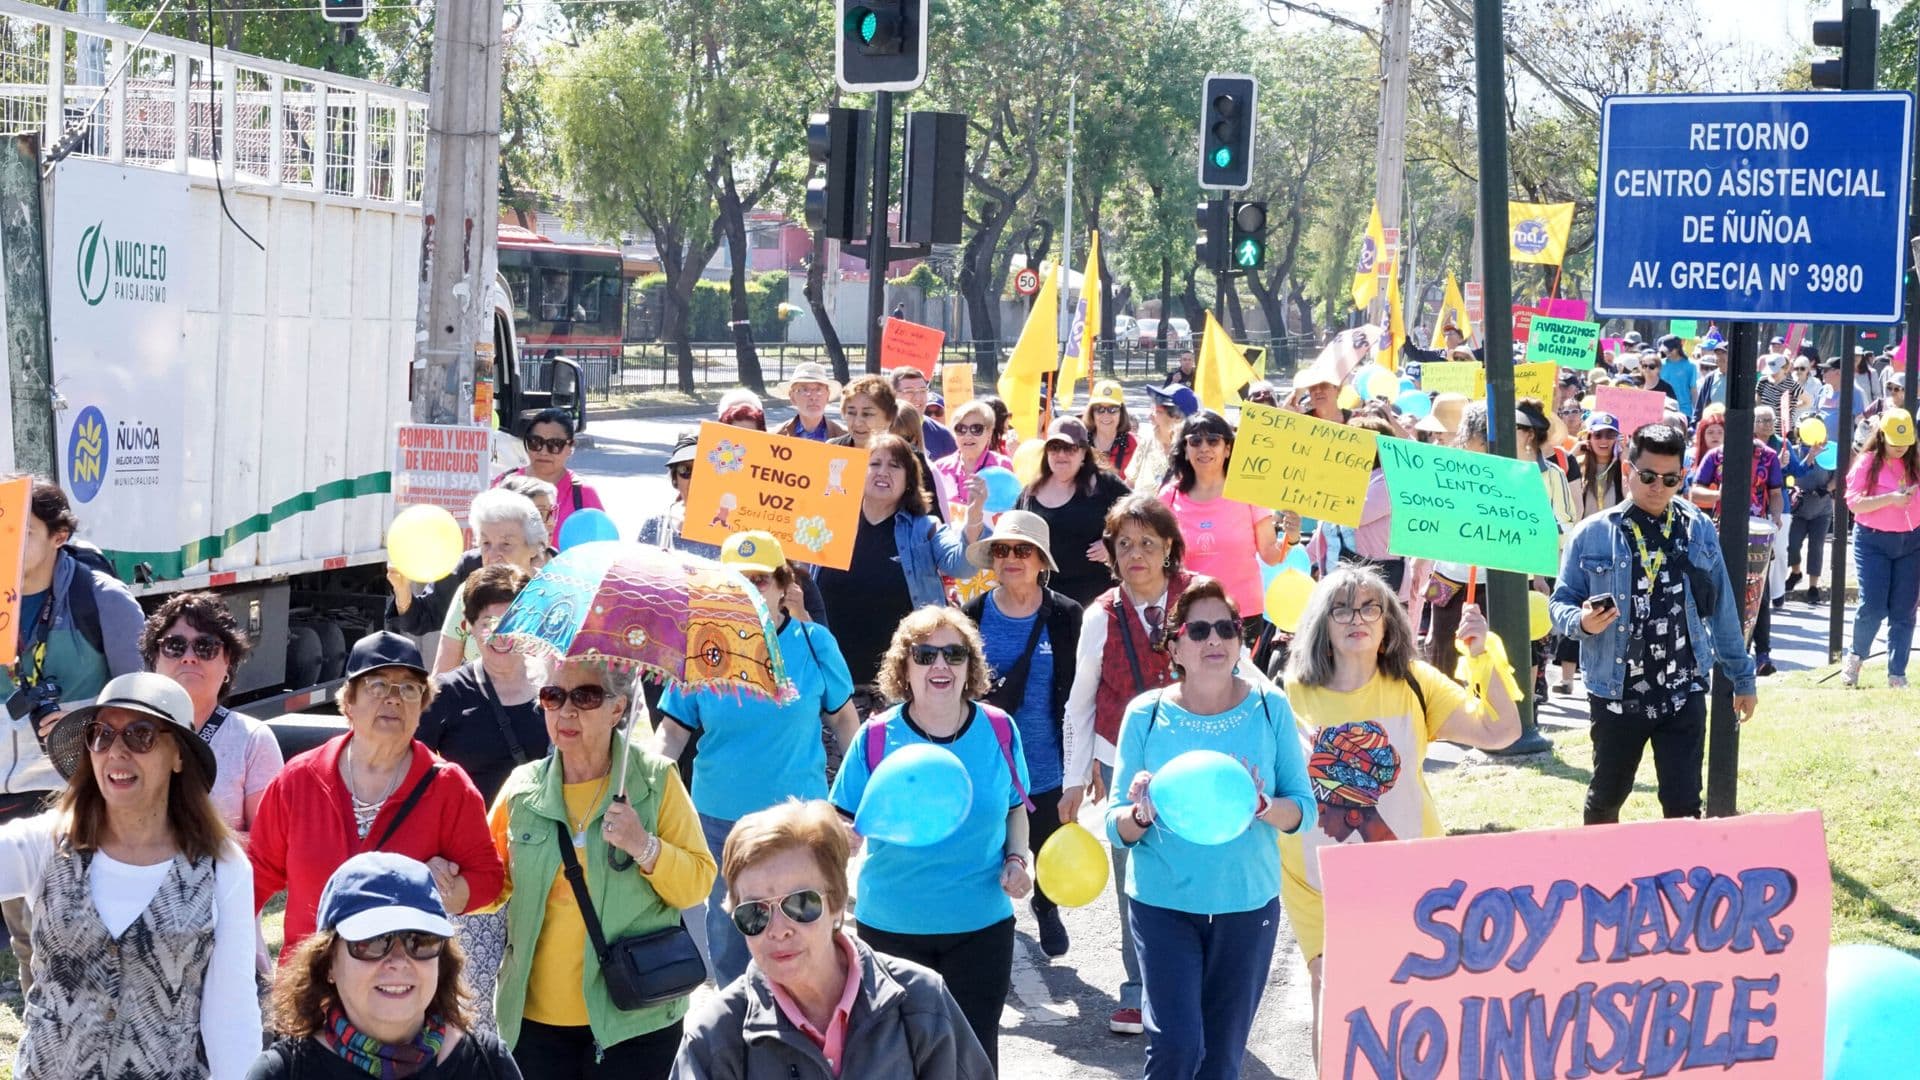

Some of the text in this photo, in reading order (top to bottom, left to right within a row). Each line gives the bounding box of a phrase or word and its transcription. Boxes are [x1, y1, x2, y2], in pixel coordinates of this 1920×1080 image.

[1689, 121, 1810, 151] RETORNO
[1614, 167, 1886, 197] CENTRO ASISTENCIAL
[1682, 209, 1812, 244] DE ÑUÑOA
[115, 240, 167, 281] NUCLEO
[1020, 276, 1036, 288] 50
[1628, 261, 1864, 293] AV. GRECIA N° 3980
[114, 282, 167, 303] PAISAJISMO
[1535, 321, 1597, 338] AVANZAMOS
[1551, 334, 1577, 345] CON
[1538, 343, 1587, 358] DIGNIDAD
[116, 420, 160, 450] ÑUÑOA
[398, 427, 444, 449] COMPRA
[447, 429, 454, 450] Y
[455, 430, 488, 452] VENTA
[1311, 424, 1361, 444] MAYOR
[405, 450, 479, 473] DE VEHICULOS
[770, 443, 793, 461] YO
[1252, 433, 1373, 473] ES UN LOGRO
[750, 464, 811, 489] TENGO
[1241, 456, 1307, 482] NO UN
[1433, 457, 1495, 479] SOMOS
[759, 492, 795, 511] VOZ
[1400, 491, 1455, 510] SOMOS
[1407, 518, 1440, 533] CON
[1390, 879, 1579, 984] SOY
[1342, 973, 1781, 1080] NO INVISIBLE
